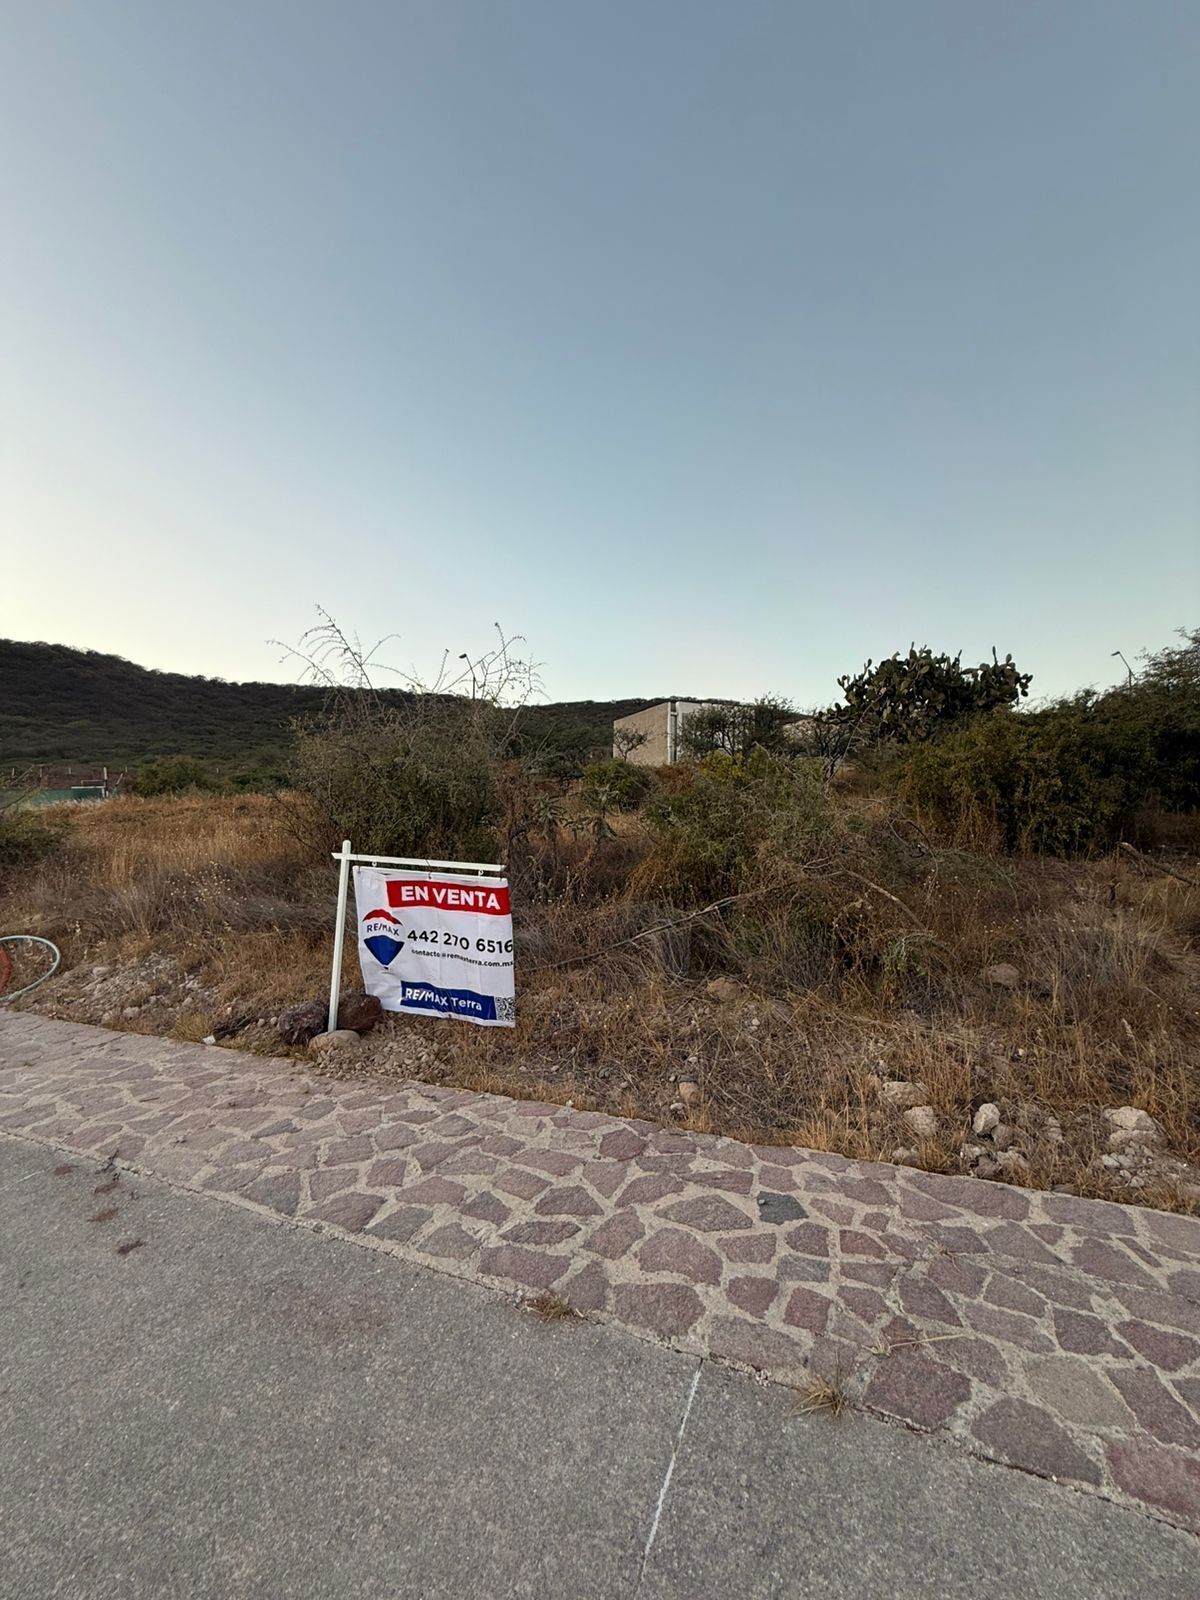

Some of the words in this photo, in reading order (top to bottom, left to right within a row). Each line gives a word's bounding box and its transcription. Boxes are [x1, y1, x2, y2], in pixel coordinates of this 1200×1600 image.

[401, 886, 429, 901] EN
[432, 888, 500, 910] VENTA
[366, 922, 400, 936] RE/MAX
[407, 930, 438, 943] 442
[443, 932, 470, 950] 270
[476, 938, 513, 953] 6516
[405, 988, 448, 1006] RE/MAX
[451, 998, 482, 1011] Terra
